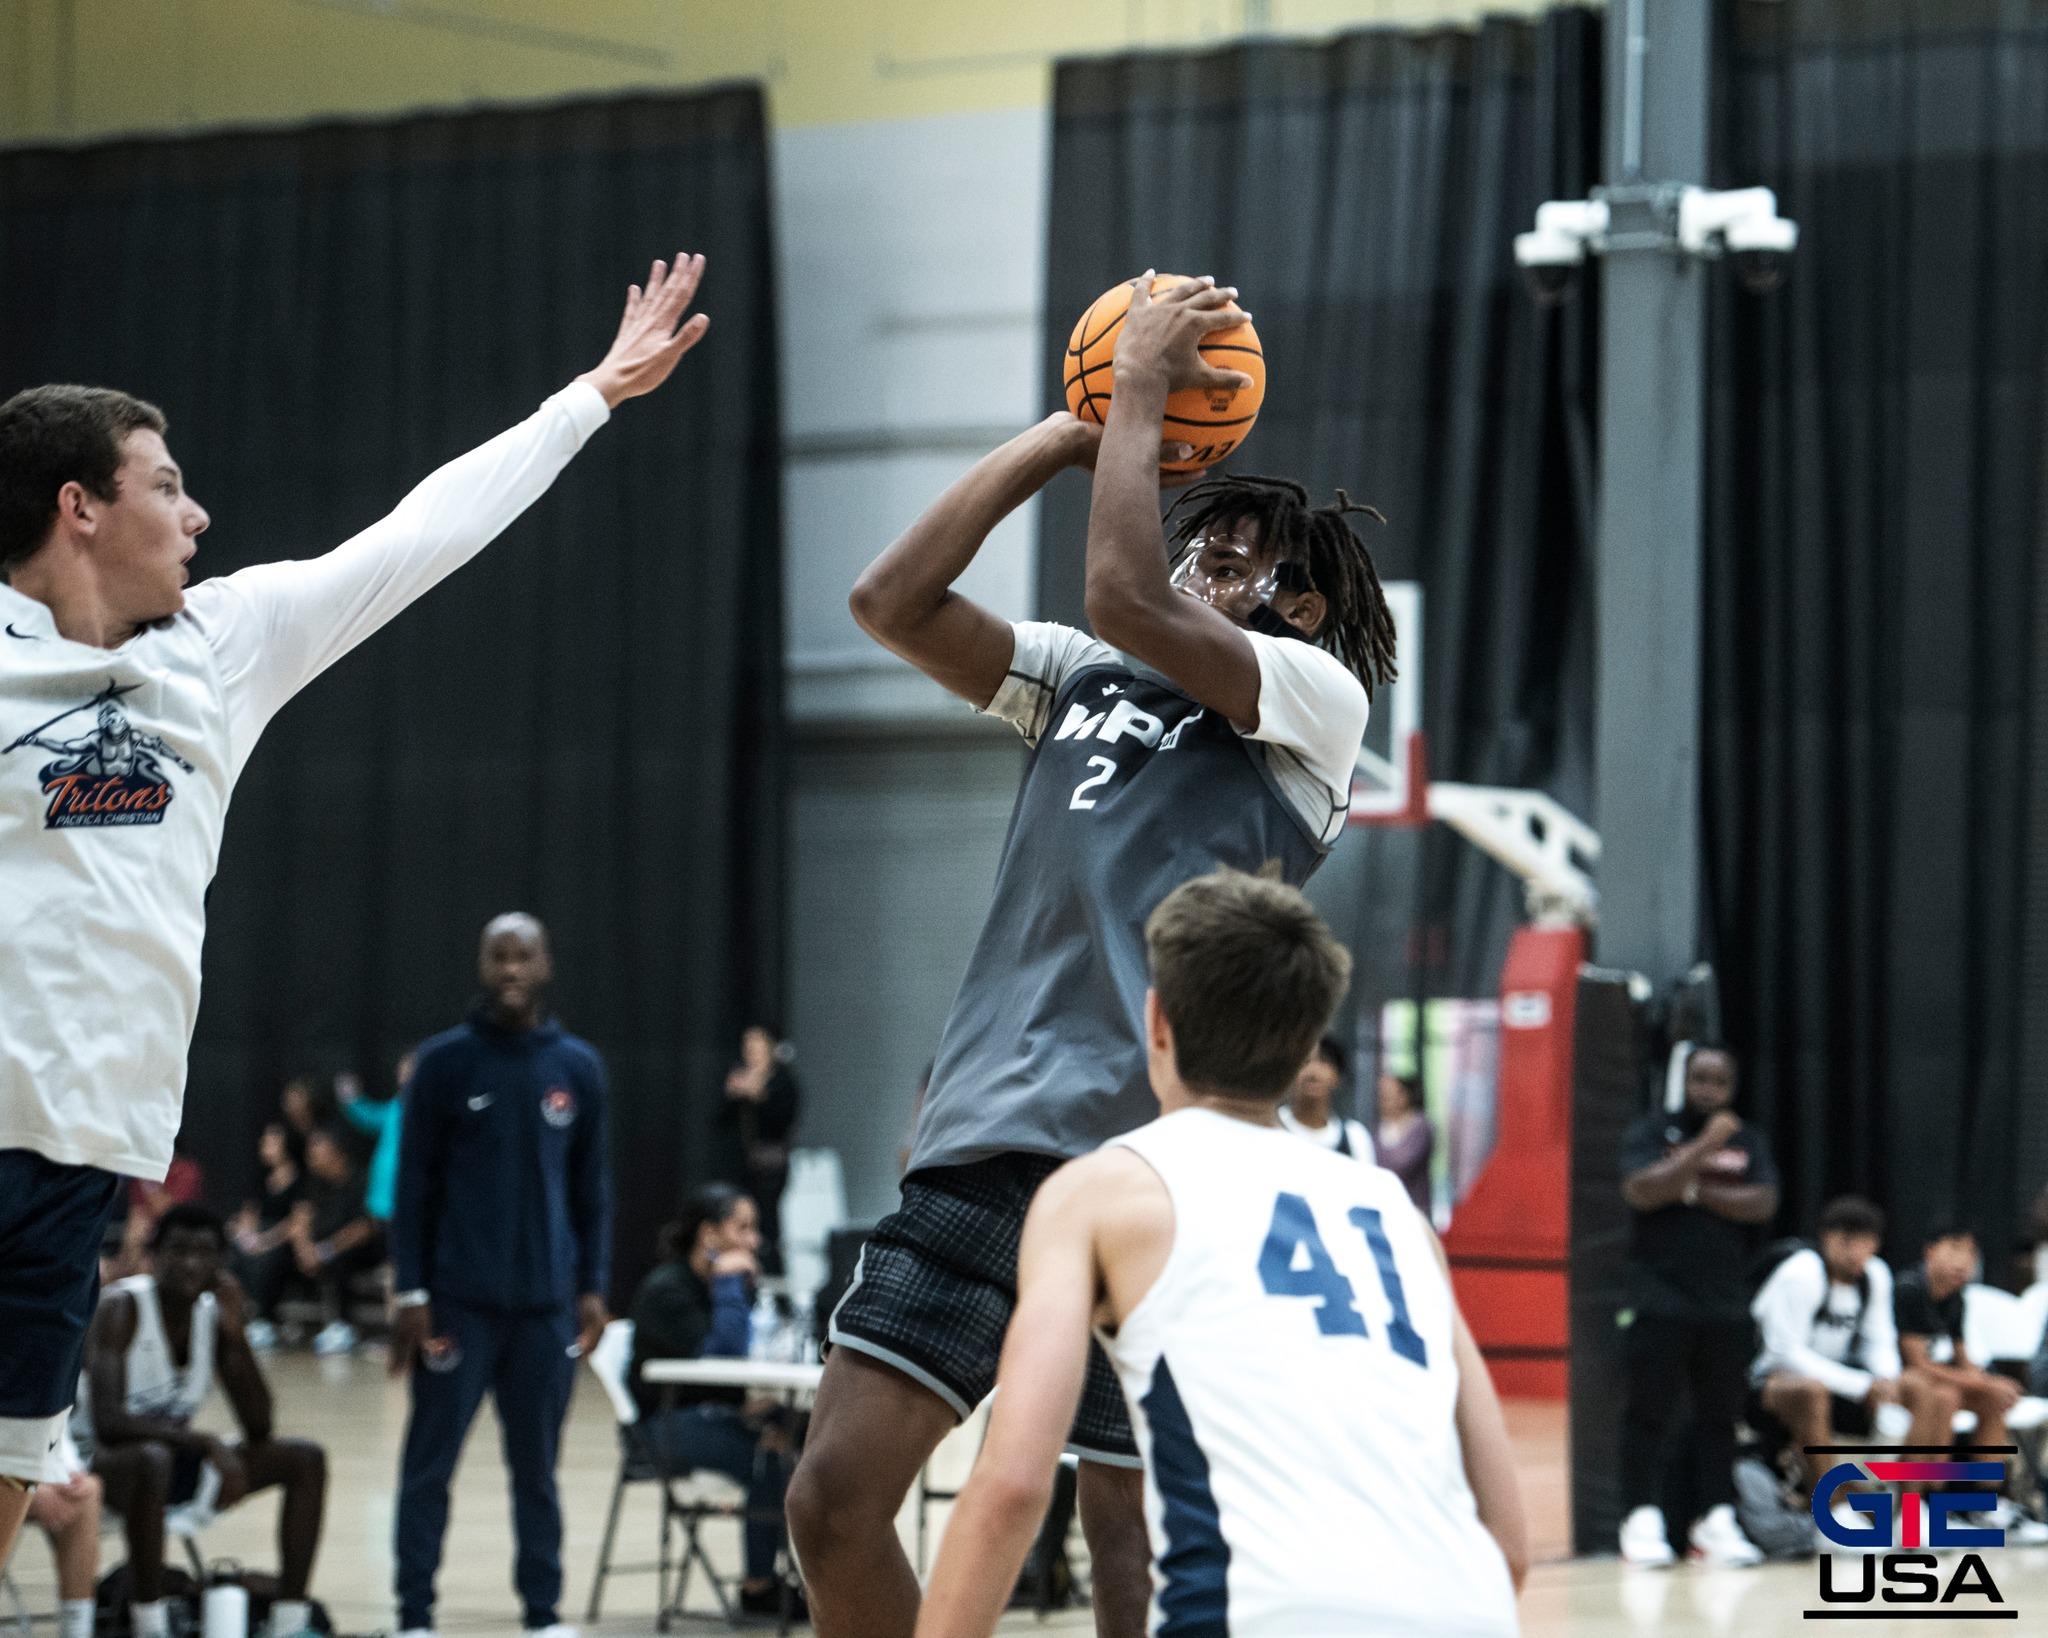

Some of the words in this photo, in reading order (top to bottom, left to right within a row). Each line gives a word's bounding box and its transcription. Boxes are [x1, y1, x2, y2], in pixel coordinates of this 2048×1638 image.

[45, 774, 173, 817] Tritons
[1068, 755, 1117, 810] 2
[55, 814, 101, 826] PACIFICA
[103, 812, 161, 825] CHRISTIAN
[1257, 1191, 1429, 1370] 41
